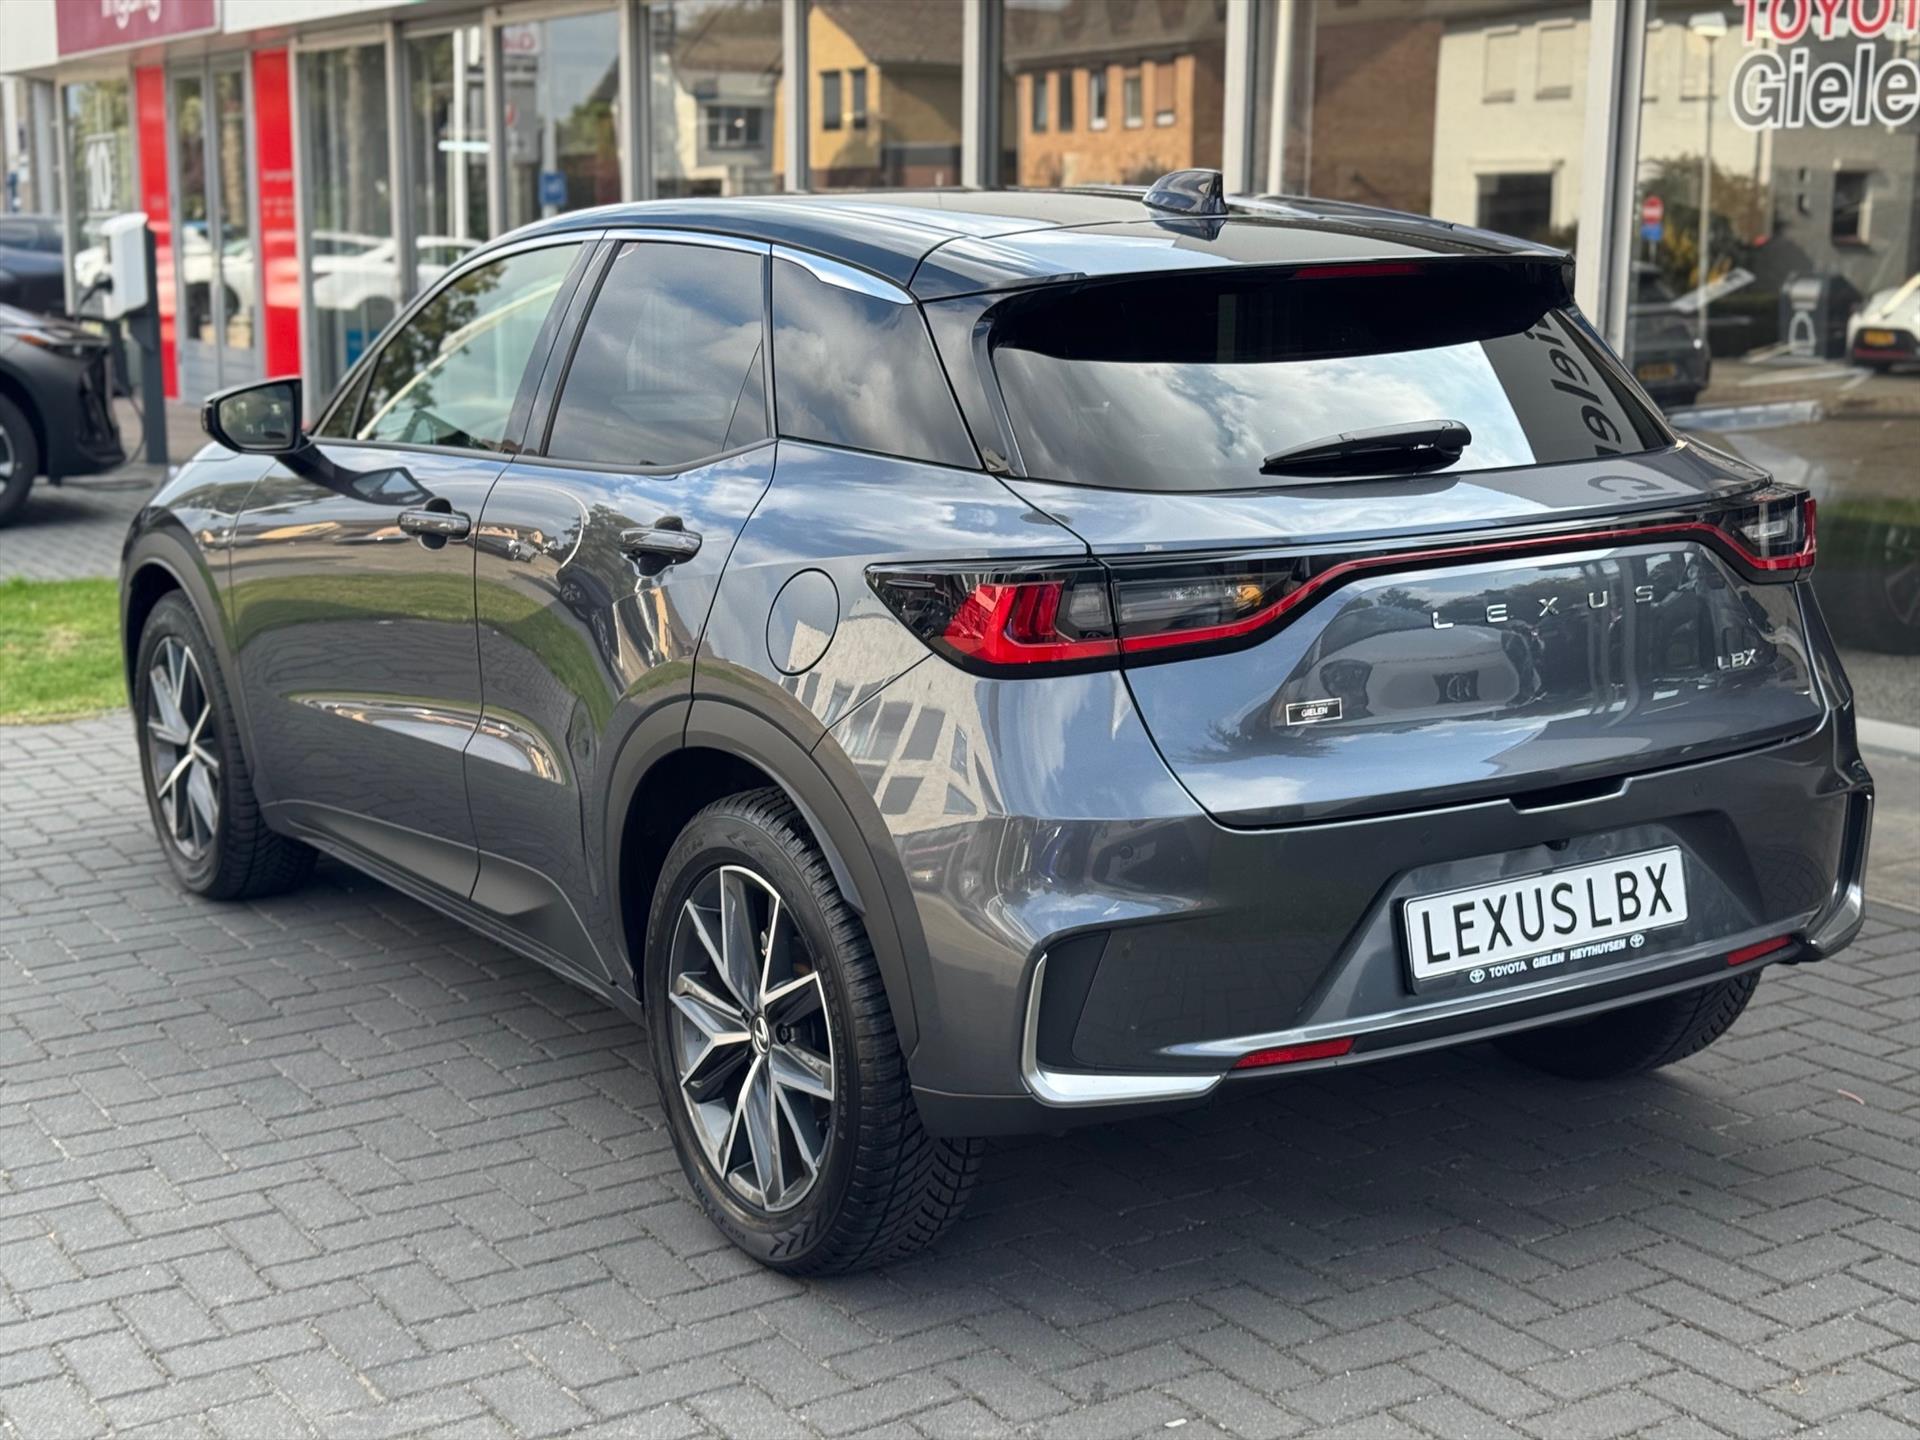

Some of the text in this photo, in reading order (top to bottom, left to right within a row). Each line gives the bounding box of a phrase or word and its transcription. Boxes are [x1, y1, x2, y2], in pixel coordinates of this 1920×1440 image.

[1729, 43, 1920, 132] Giele
[1432, 585, 1654, 630] LEXUS
[1717, 648, 1757, 669] LBX
[1489, 938, 1626, 978] TOYOTA GIELEN HEYTHUYSEN
